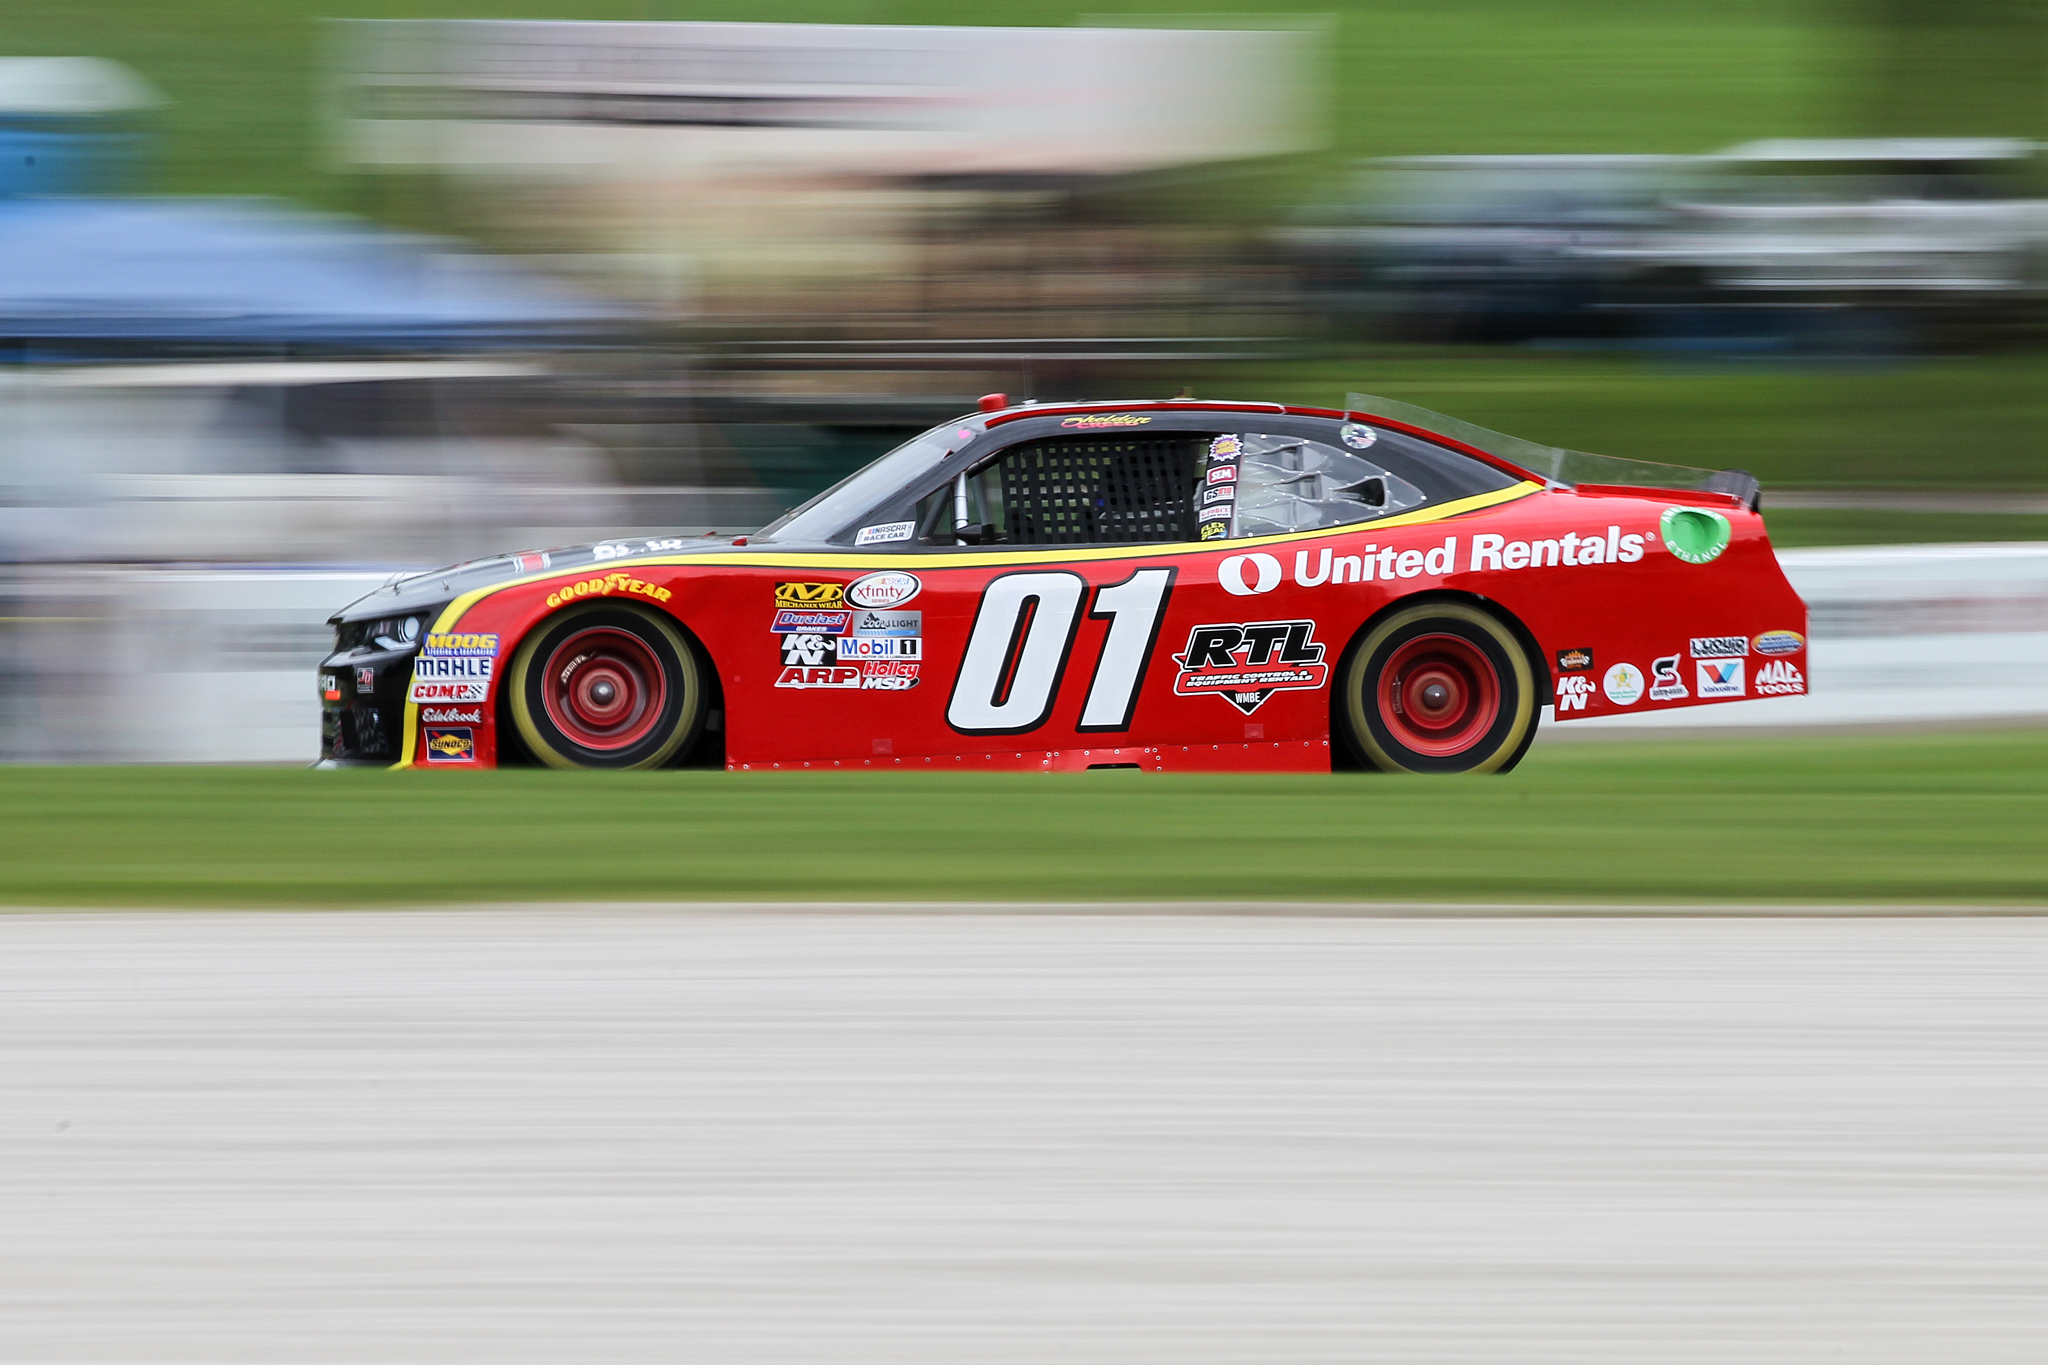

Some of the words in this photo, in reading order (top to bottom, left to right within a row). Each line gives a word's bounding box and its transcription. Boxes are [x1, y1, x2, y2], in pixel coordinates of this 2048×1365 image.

[1211, 468, 1232, 481] SEM
[874, 524, 907, 534] NASCAR
[1200, 521, 1226, 535] FLEX
[1201, 527, 1227, 541] SEAL
[863, 534, 886, 542] RACE
[1665, 540, 1729, 564] ETHANOL
[1294, 537, 1456, 588] United
[857, 584, 905, 600] xfinity
[775, 599, 818, 608] MECHANIX
[818, 600, 843, 609] WEAR
[778, 612, 845, 625] Duralast
[892, 620, 918, 628] LIGHT
[425, 633, 499, 649] MOOG
[841, 639, 894, 655] Mobil
[1185, 623, 1323, 669] RTL
[945, 567, 1175, 733] 01
[416, 659, 490, 676] MAHLE
[862, 661, 920, 680] Holley
[1755, 659, 1804, 685] MAC
[779, 668, 858, 684] ARP
[1186, 677, 1257, 687] EQUIPMENT
[1260, 674, 1314, 683] RENTALS
[1189, 672, 1240, 681] TRAFFIC
[1242, 670, 1293, 679] CONTROL
[414, 685, 469, 697] COMP
[861, 677, 911, 691] MSD
[1702, 684, 1739, 693] Valvoline
[1755, 683, 1805, 695] TOOLS
[1234, 691, 1260, 703] WMBE
[422, 707, 482, 723] Edelbrock
[431, 739, 470, 749] SUNOCO
